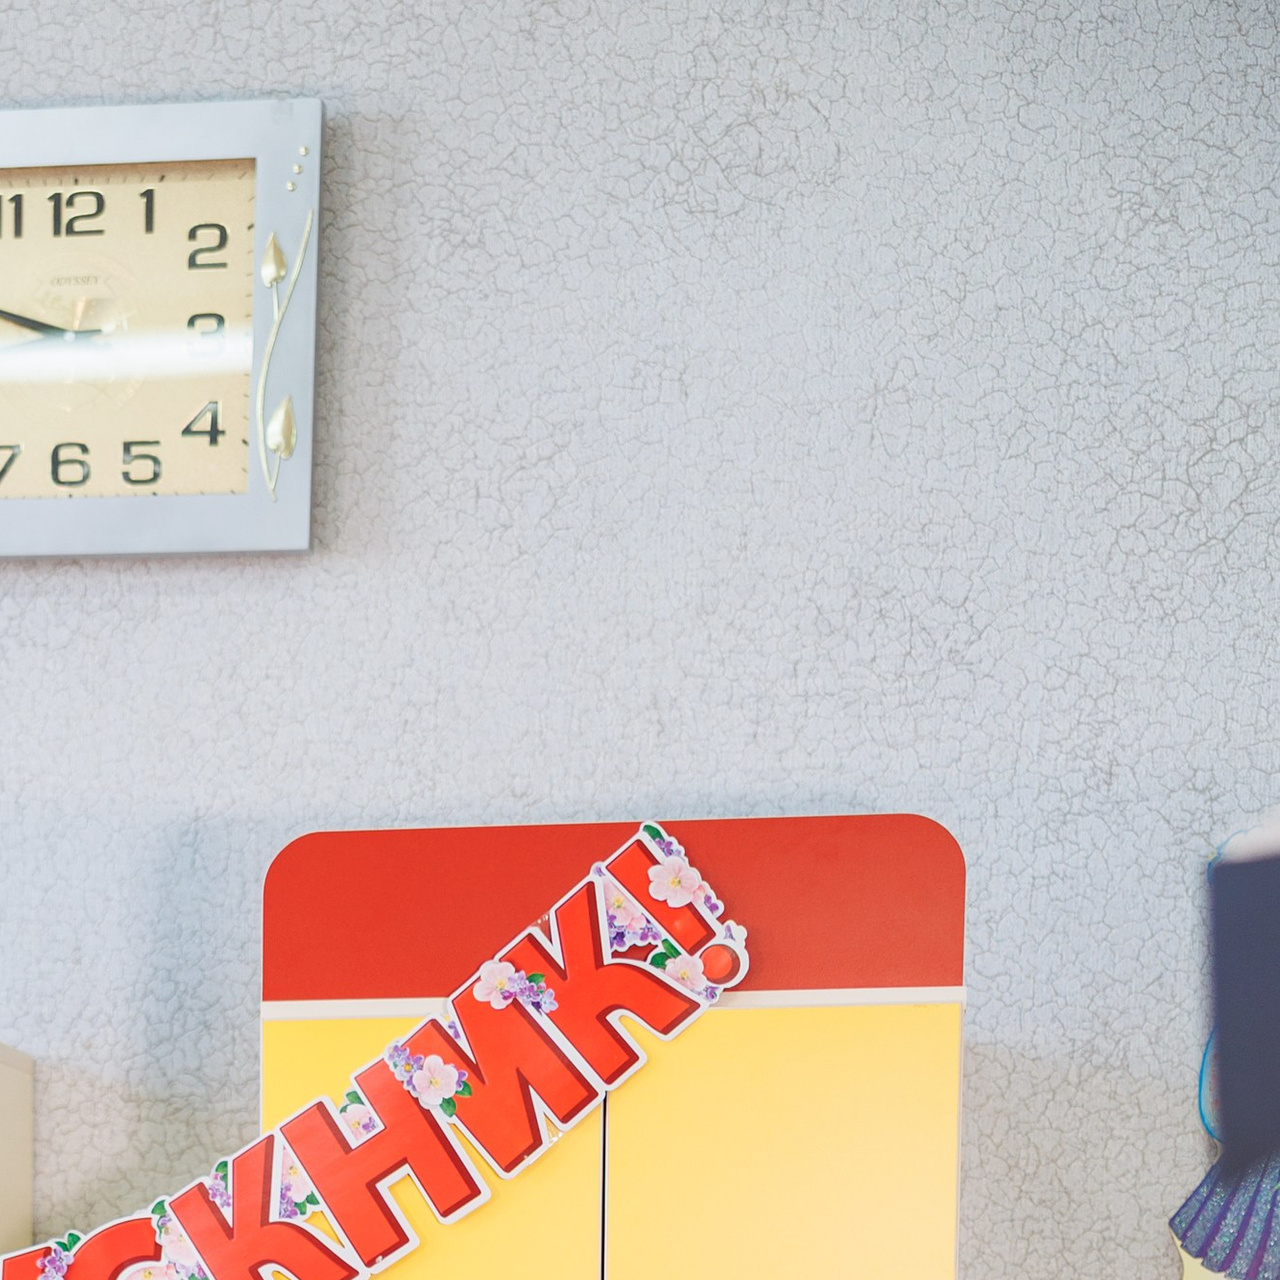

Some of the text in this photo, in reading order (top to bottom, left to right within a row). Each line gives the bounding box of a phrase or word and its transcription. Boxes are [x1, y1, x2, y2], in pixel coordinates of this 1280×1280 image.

[47, 191, 105, 237] 12
[140, 188, 155, 234] 1
[187, 222, 229, 270] 2
[181, 401, 226, 446] 4
[50, 442, 91, 487] 6
[121, 440, 162, 485] 5
